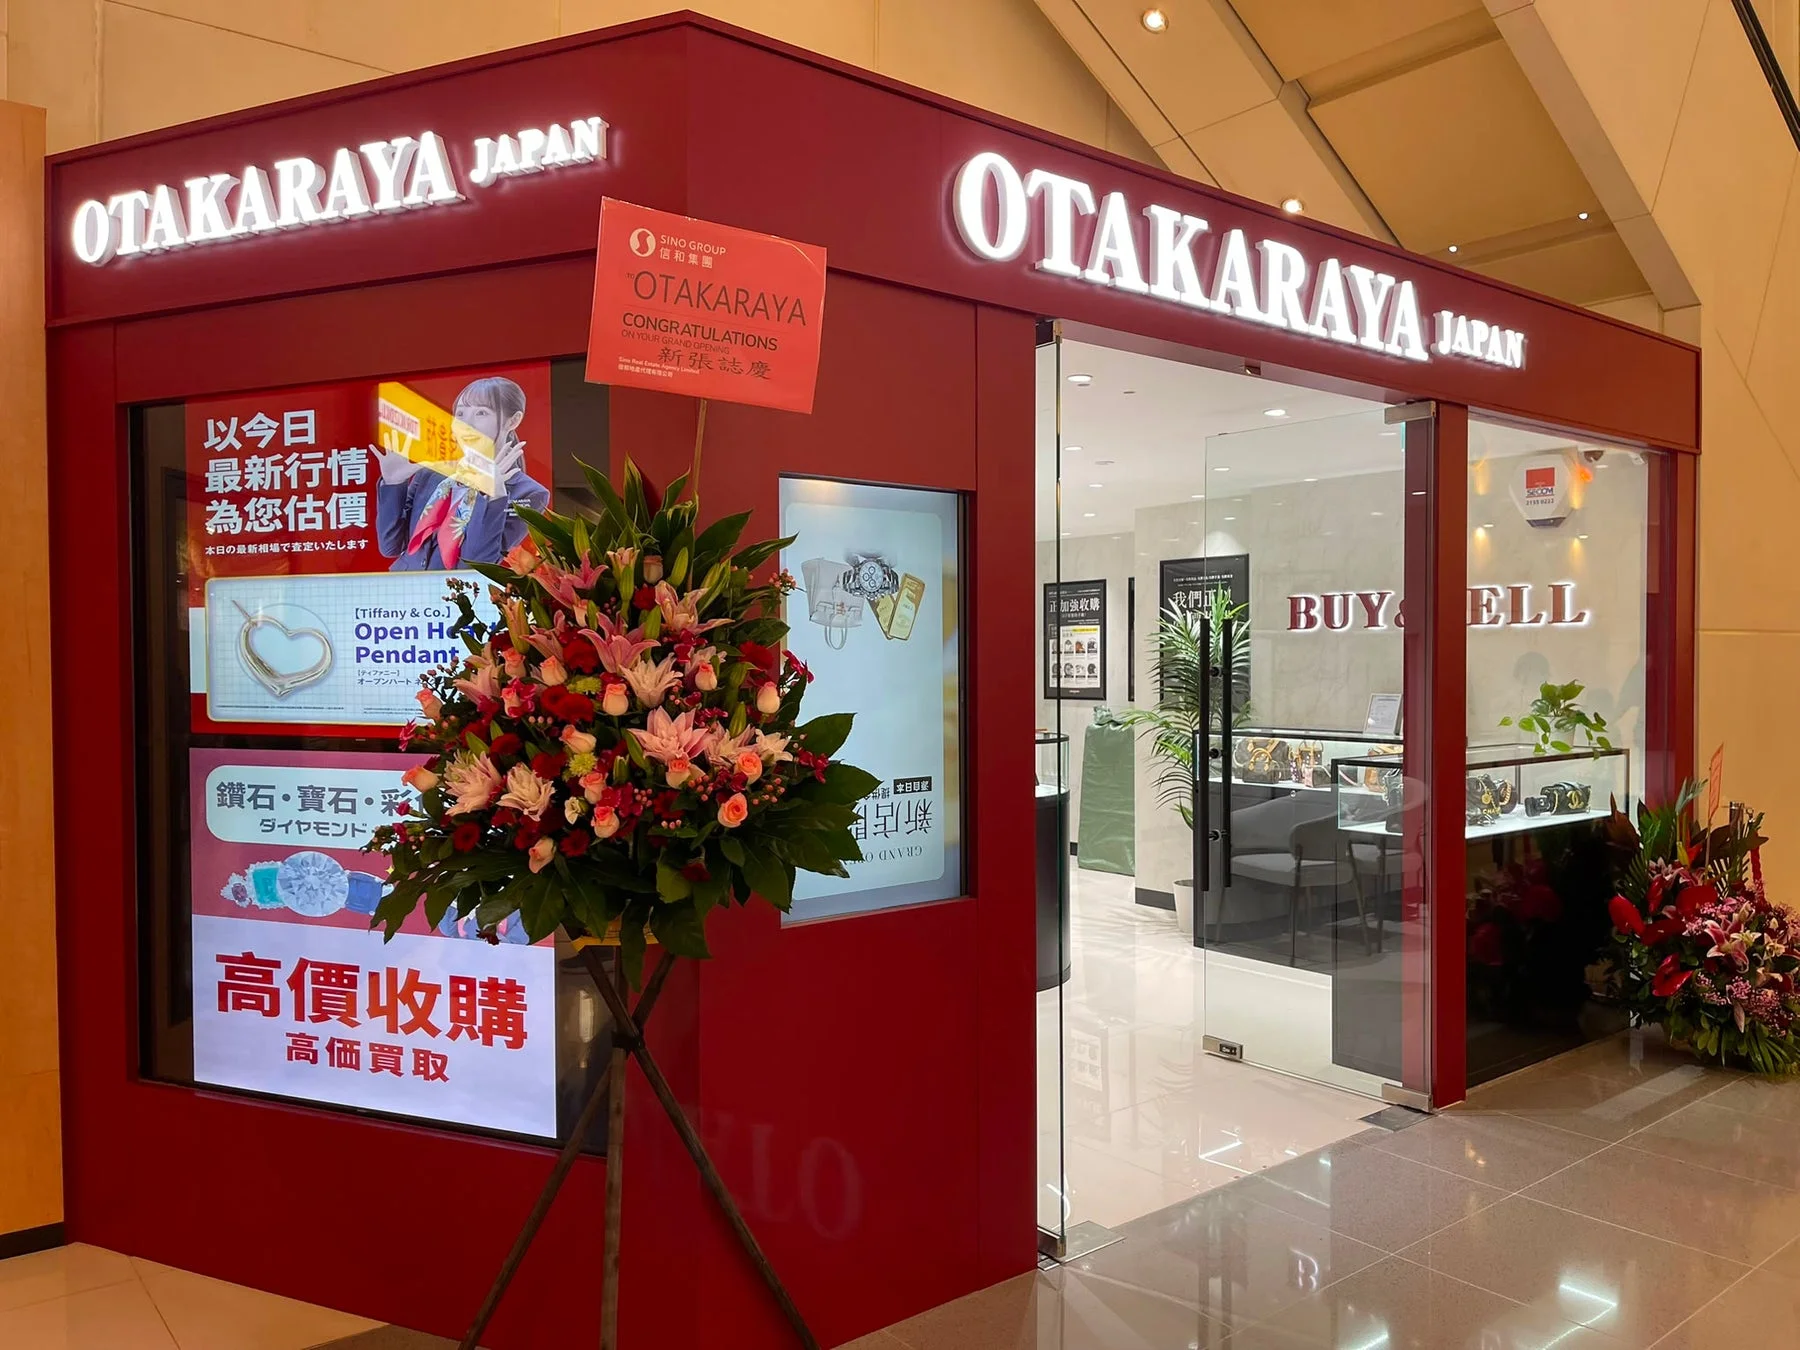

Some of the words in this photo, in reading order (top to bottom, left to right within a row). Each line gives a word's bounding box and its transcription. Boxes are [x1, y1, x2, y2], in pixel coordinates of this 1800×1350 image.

[71, 130, 463, 265] OTAKARAYA
[470, 116, 607, 186] JAPAN
[659, 246, 713, 269] 信和集團
[660, 234, 687, 249] SINO
[688, 240, 727, 256] GROUP
[953, 151, 1430, 361] OTAKARAYA
[1434, 310, 1526, 370] JAPAN
[633, 270, 806, 326] OTAKARAYA
[621, 329, 634, 340] ON
[636, 331, 660, 344] YOUR
[661, 335, 693, 349] GRAND
[693, 340, 730, 355] OPENING
[622, 312, 778, 351] CONGRATULATIONS
[658, 346, 772, 380] 新張誌慶
[203, 408, 316, 452] 以今日
[204, 447, 369, 495] 最新行情
[204, 492, 369, 536] 為您估價
[205, 538, 369, 556] 本日の最新相場で査定いたします
[410, 607, 420, 618] &
[1287, 590, 1393, 631] BUY
[1466, 582, 1587, 626] ELL
[354, 622, 419, 644] Open
[355, 645, 460, 664] Pendant
[879, 845, 923, 861] GRAND
[215, 951, 529, 1050] 高價收購
[285, 1032, 450, 1083] 高価買取
